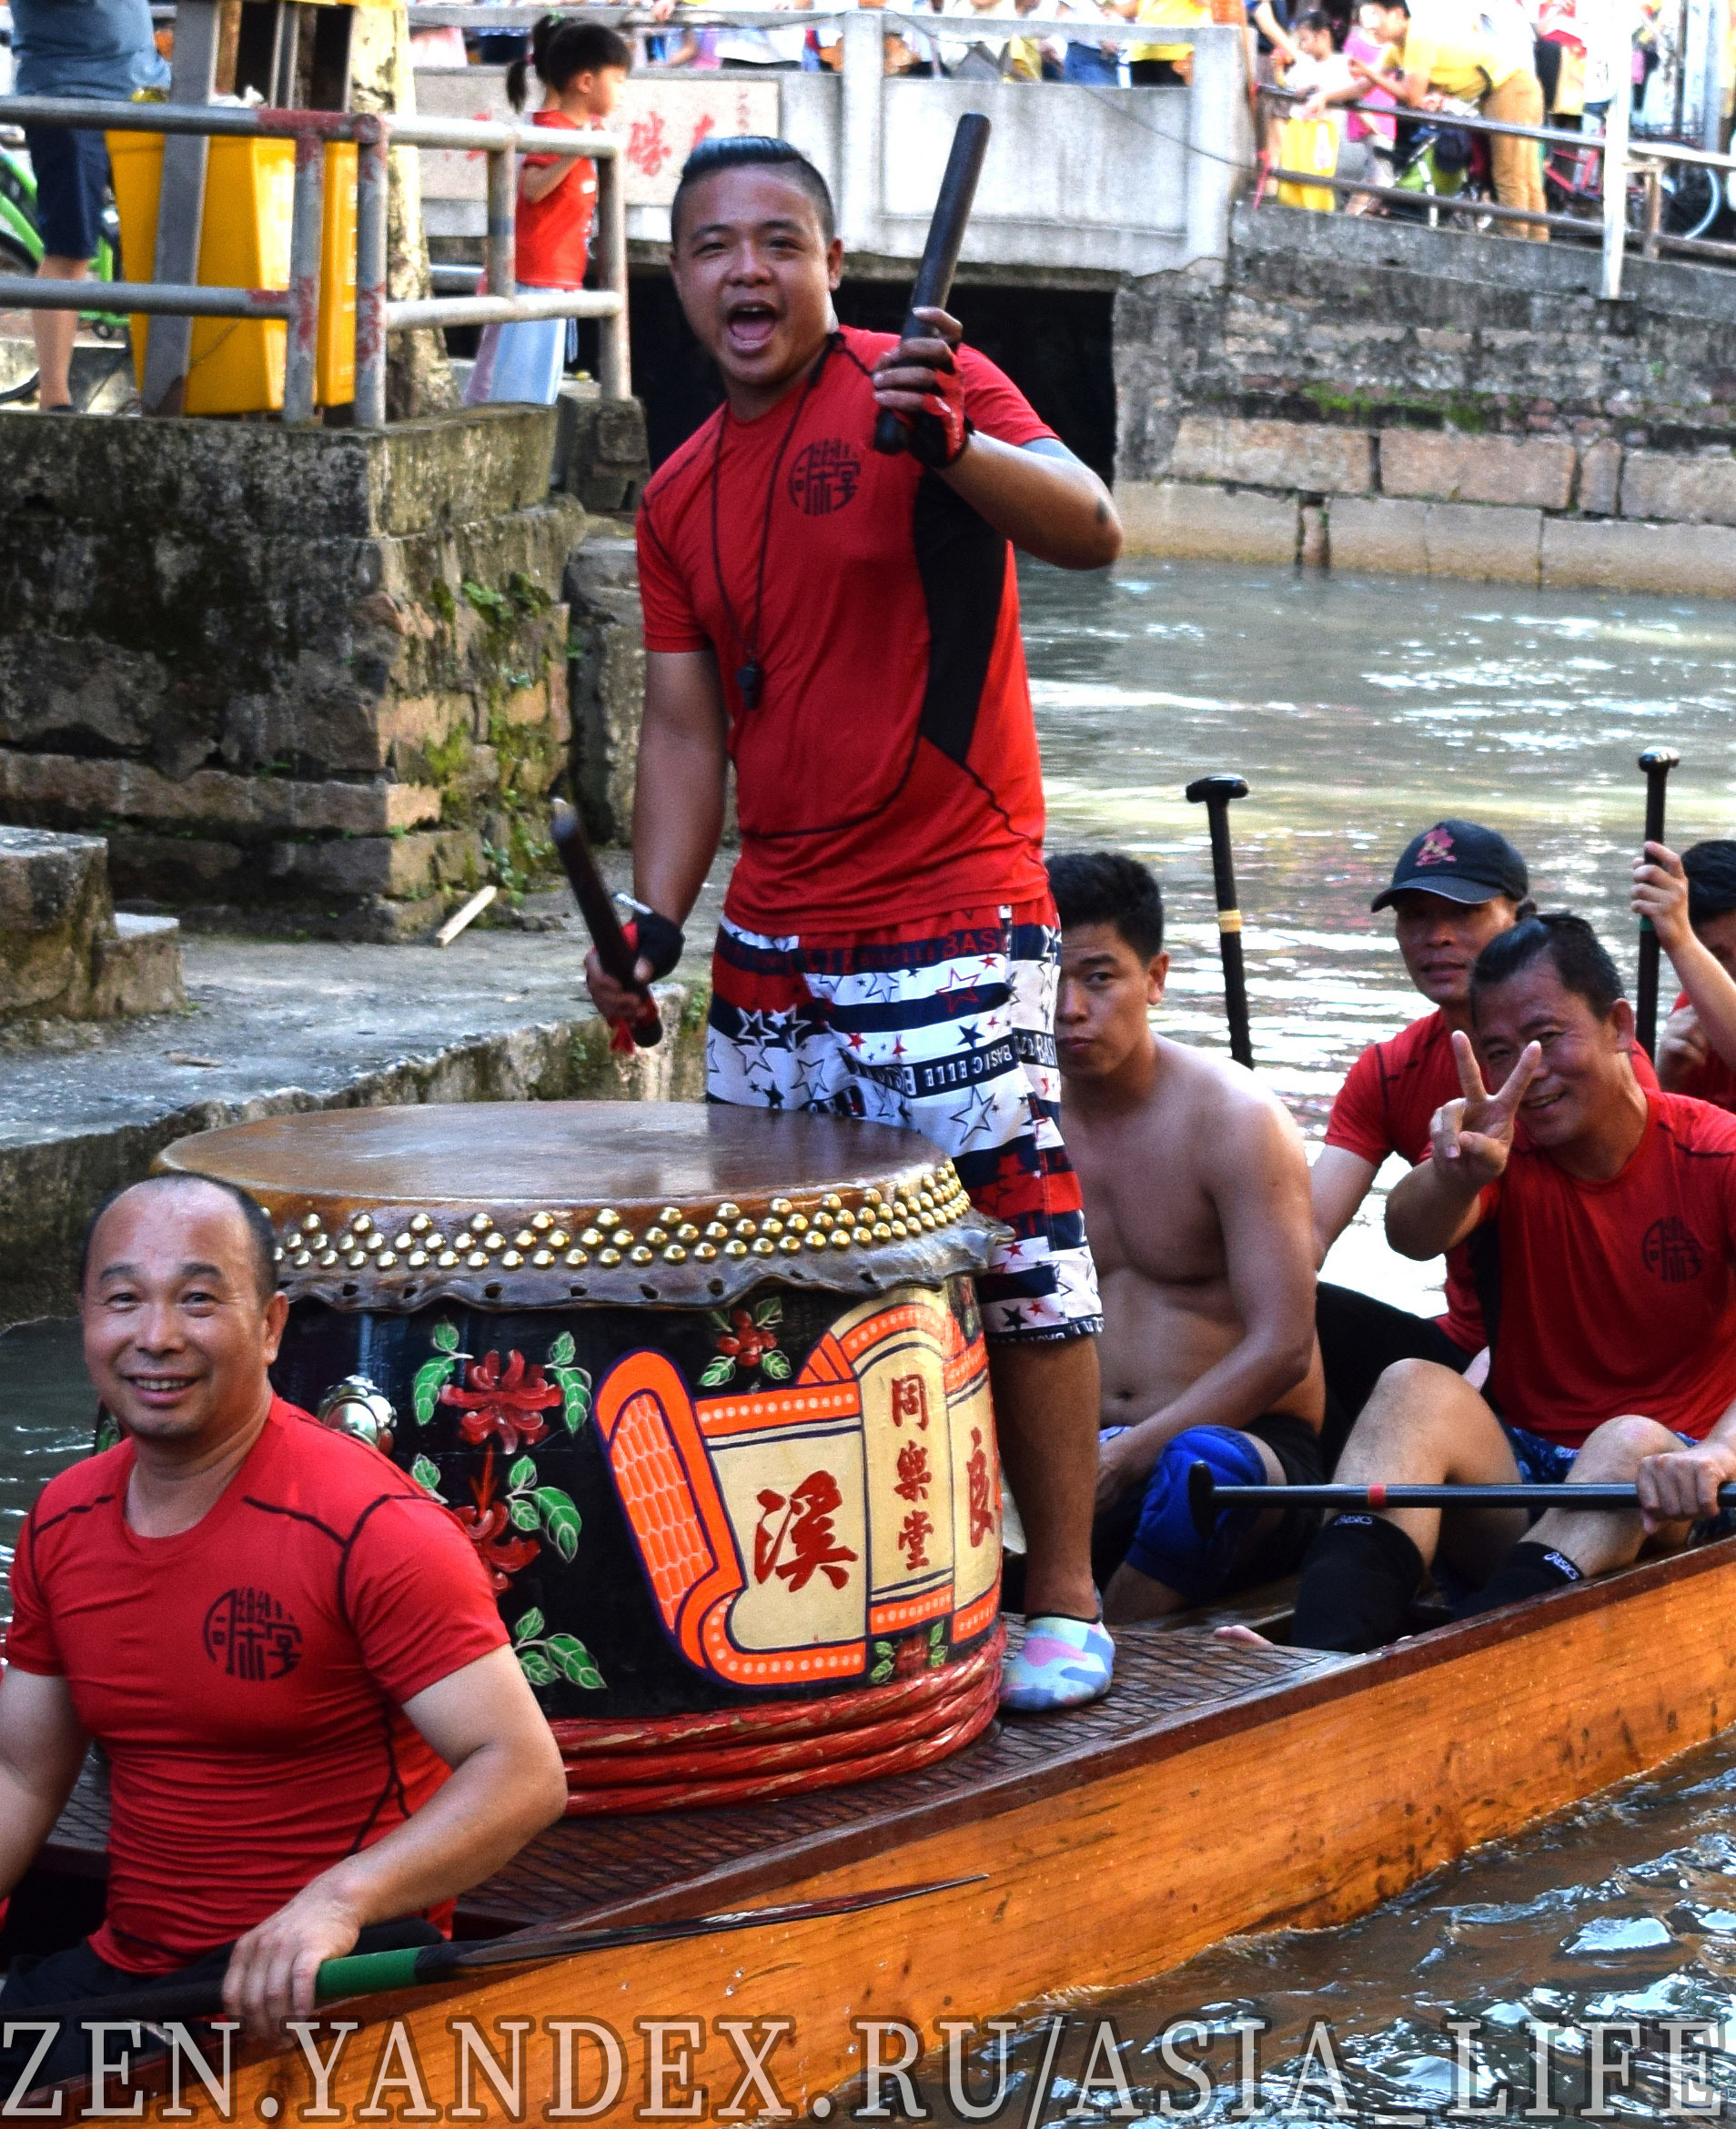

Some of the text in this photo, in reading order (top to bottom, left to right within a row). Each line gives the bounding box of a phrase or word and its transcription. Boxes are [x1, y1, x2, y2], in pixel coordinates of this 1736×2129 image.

[753, 1469, 858, 1593] 溪
[891, 1373, 934, 1571] 同樂堂
